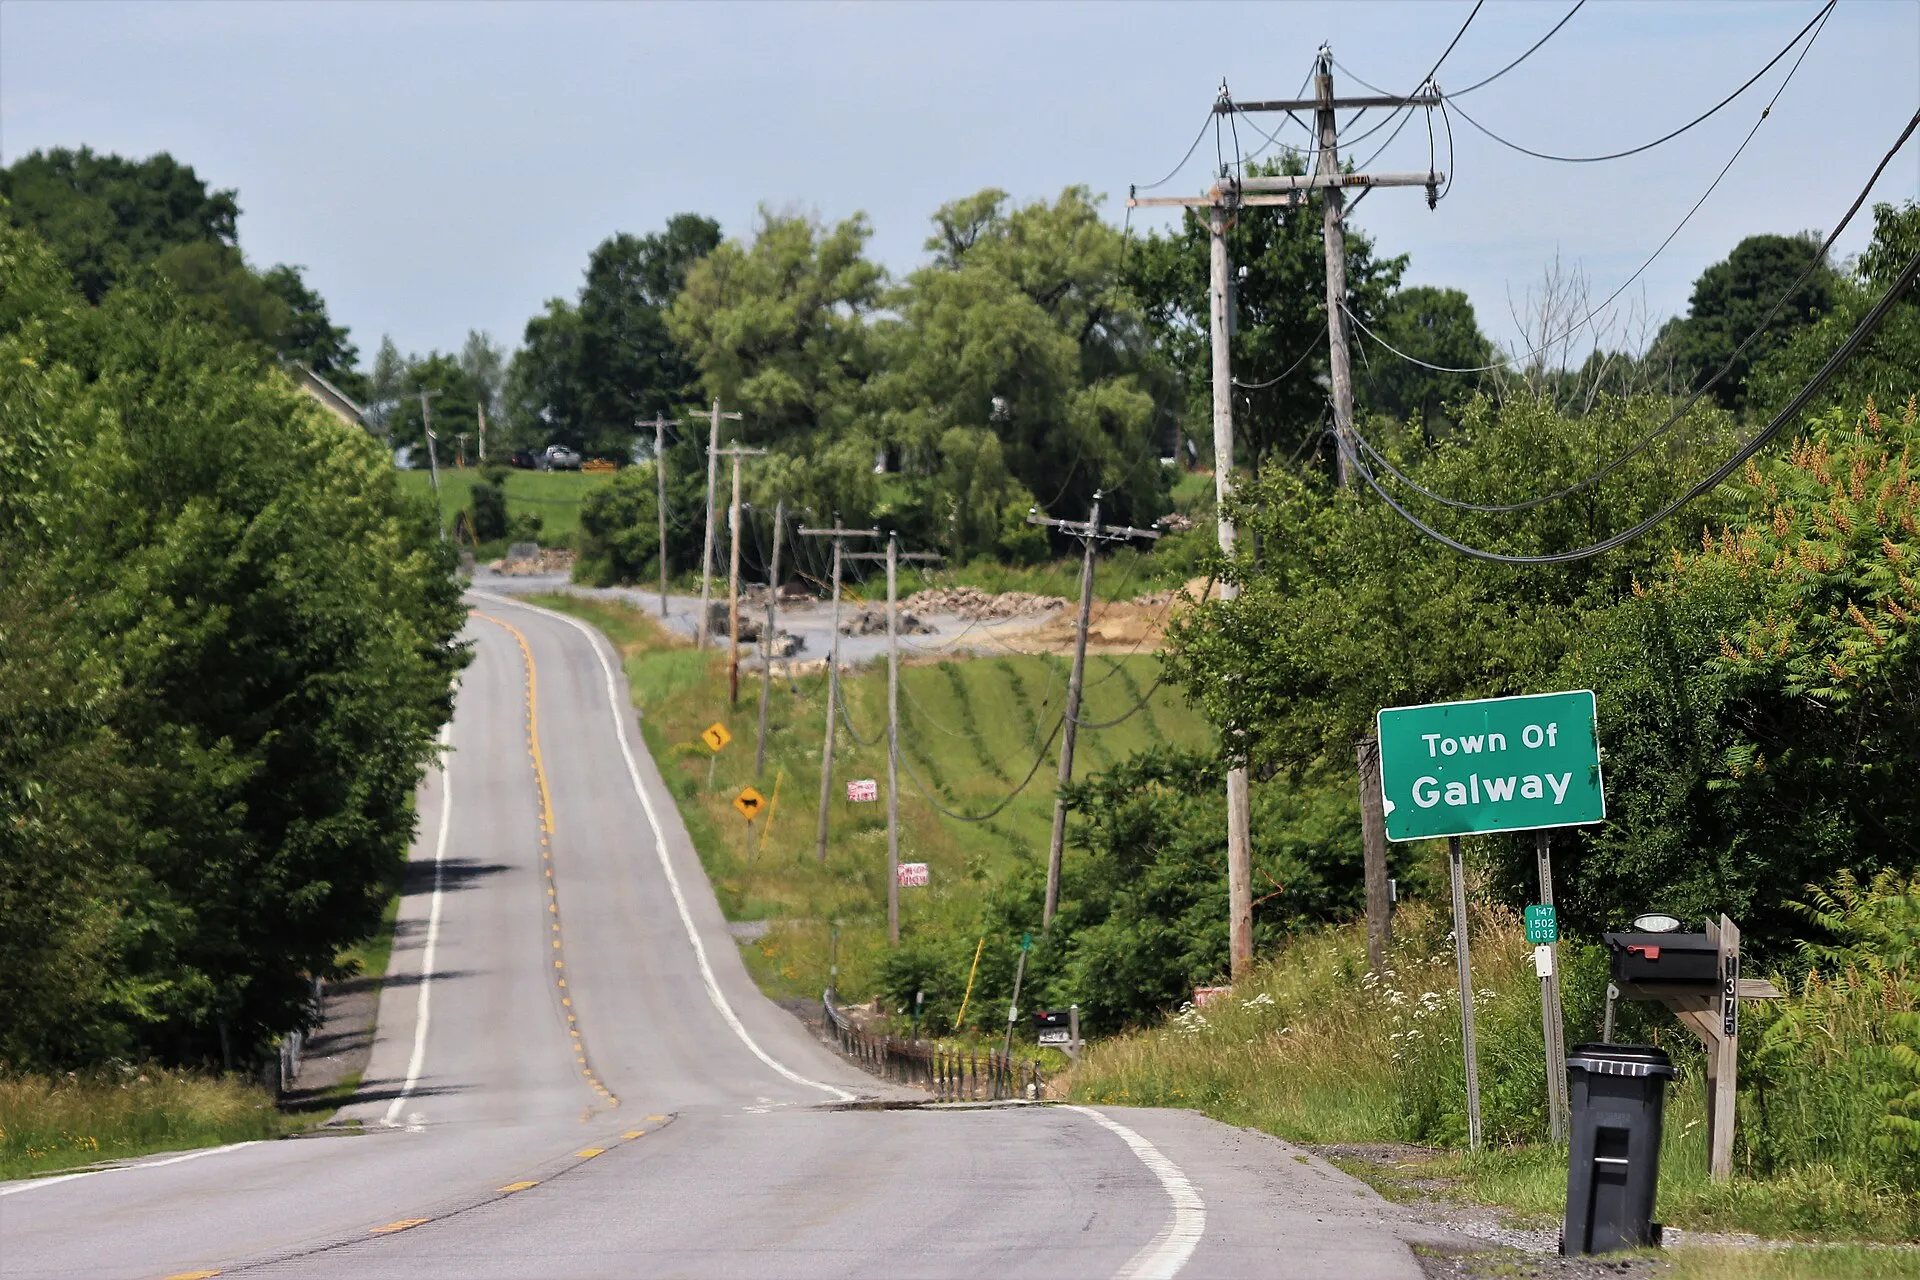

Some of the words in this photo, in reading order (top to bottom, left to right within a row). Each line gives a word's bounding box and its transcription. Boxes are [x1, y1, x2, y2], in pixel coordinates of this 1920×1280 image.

[1421, 733, 1507, 758] Town
[1522, 722, 1558, 749] Of
[1411, 772, 1573, 809] Galway
[1529, 918, 1555, 929] 1502
[1530, 929, 1555, 939] 1032
